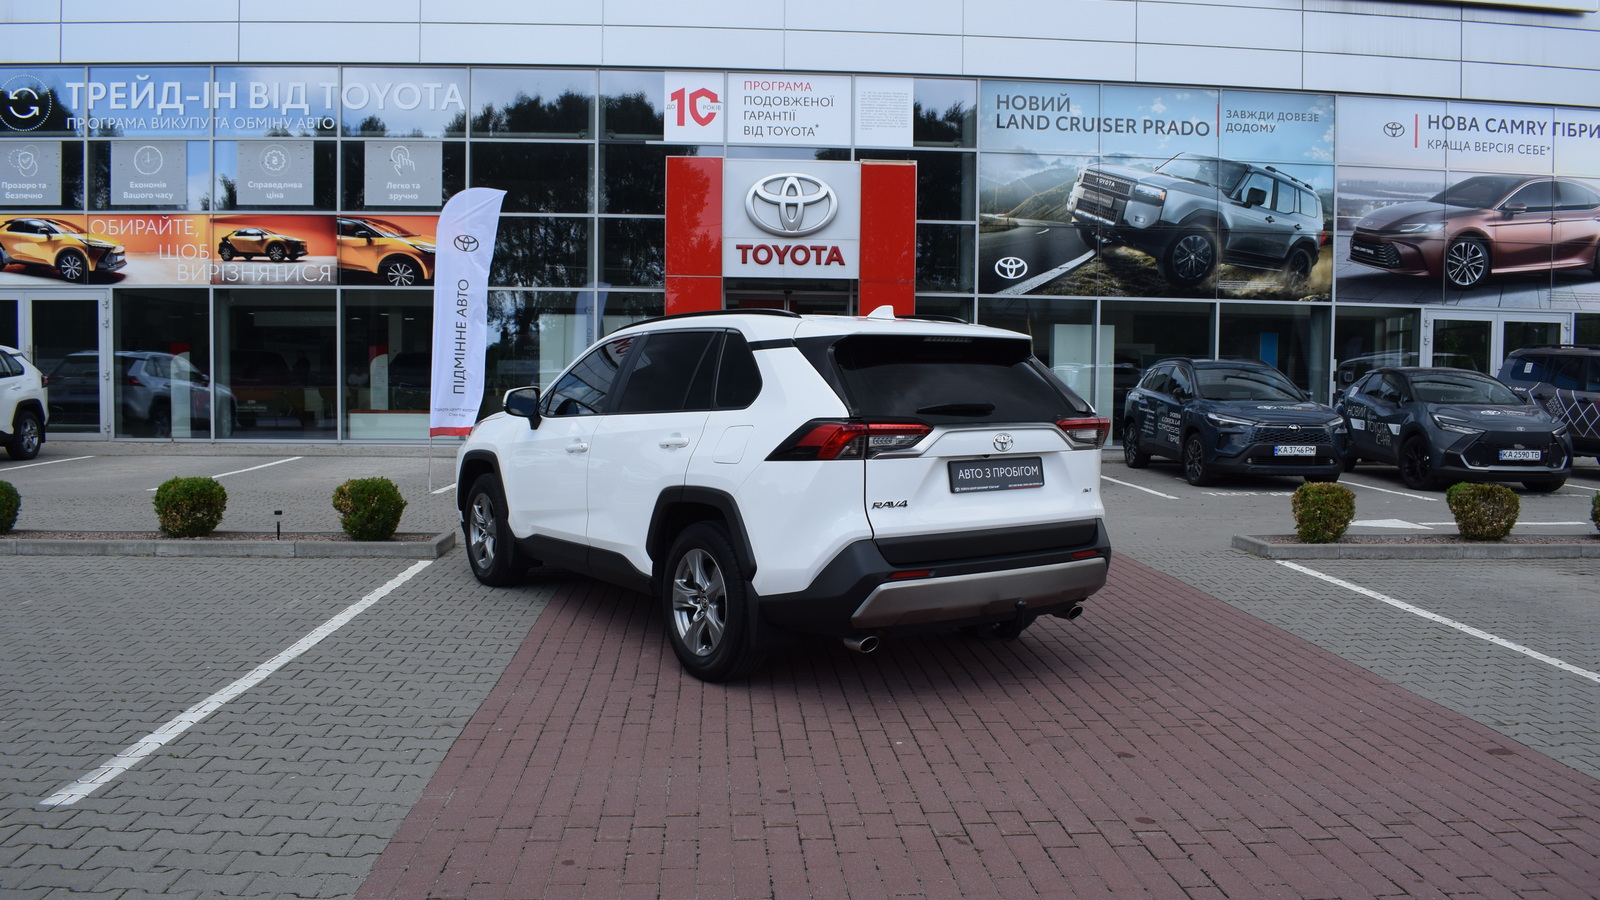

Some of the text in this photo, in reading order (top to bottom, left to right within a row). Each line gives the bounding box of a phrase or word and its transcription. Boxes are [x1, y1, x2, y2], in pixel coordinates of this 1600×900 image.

[743, 80, 812, 92] ПРОГРАМА
[66, 74, 466, 115] ТРЕЙД-ІН ВІД TOYOTA
[743, 95, 835, 107] ПОДОВЖЕНОЇ
[996, 93, 1071, 113] НОВИЙ
[743, 109, 797, 121] ГАРАНТІЇ
[1225, 110, 1320, 123] ЗАВЖДИ ДОВЕЗЕ
[66, 116, 335, 130] ПРОГРАМА ВИКУПУ ТА ОБМІНУ АВТО
[996, 114, 1211, 137] LAND CRUISER PRADO
[1225, 122, 1277, 134] ДОДОМУ
[1427, 114, 1480, 133] НОВА
[1485, 117, 1548, 136] CAMRY
[743, 125, 764, 137] ВІД
[1427, 139, 1471, 152] КРАЩА
[1474, 142, 1514, 154] ВЕРСІЯ
[1, 181, 36, 190] Прозоро
[129, 181, 167, 189] Економія
[247, 180, 303, 190] Справедлива
[386, 182, 408, 190] Легко
[5, 192, 43, 200] безпечно
[123, 192, 153, 200] Вашого
[266, 192, 284, 200] ціна
[388, 193, 419, 202] зручно
[90, 216, 199, 237] ОБИРАЙТЕ,
[158, 244, 210, 263] ЩОБ
[736, 244, 846, 266] TOYOTA
[177, 264, 332, 283] ВИРІЗНЯТИСЯ
[453, 279, 469, 395] ПІДМІННЕ АВТО
[1157, 422, 1180, 435] CROSS
[1366, 420, 1389, 434] TOYOTA
[1514, 451, 1530, 459] 2590
[958, 468, 983, 480] АВТО
[992, 466, 1039, 478] ПРОБІГОМ
[871, 500, 908, 509] RAV4
